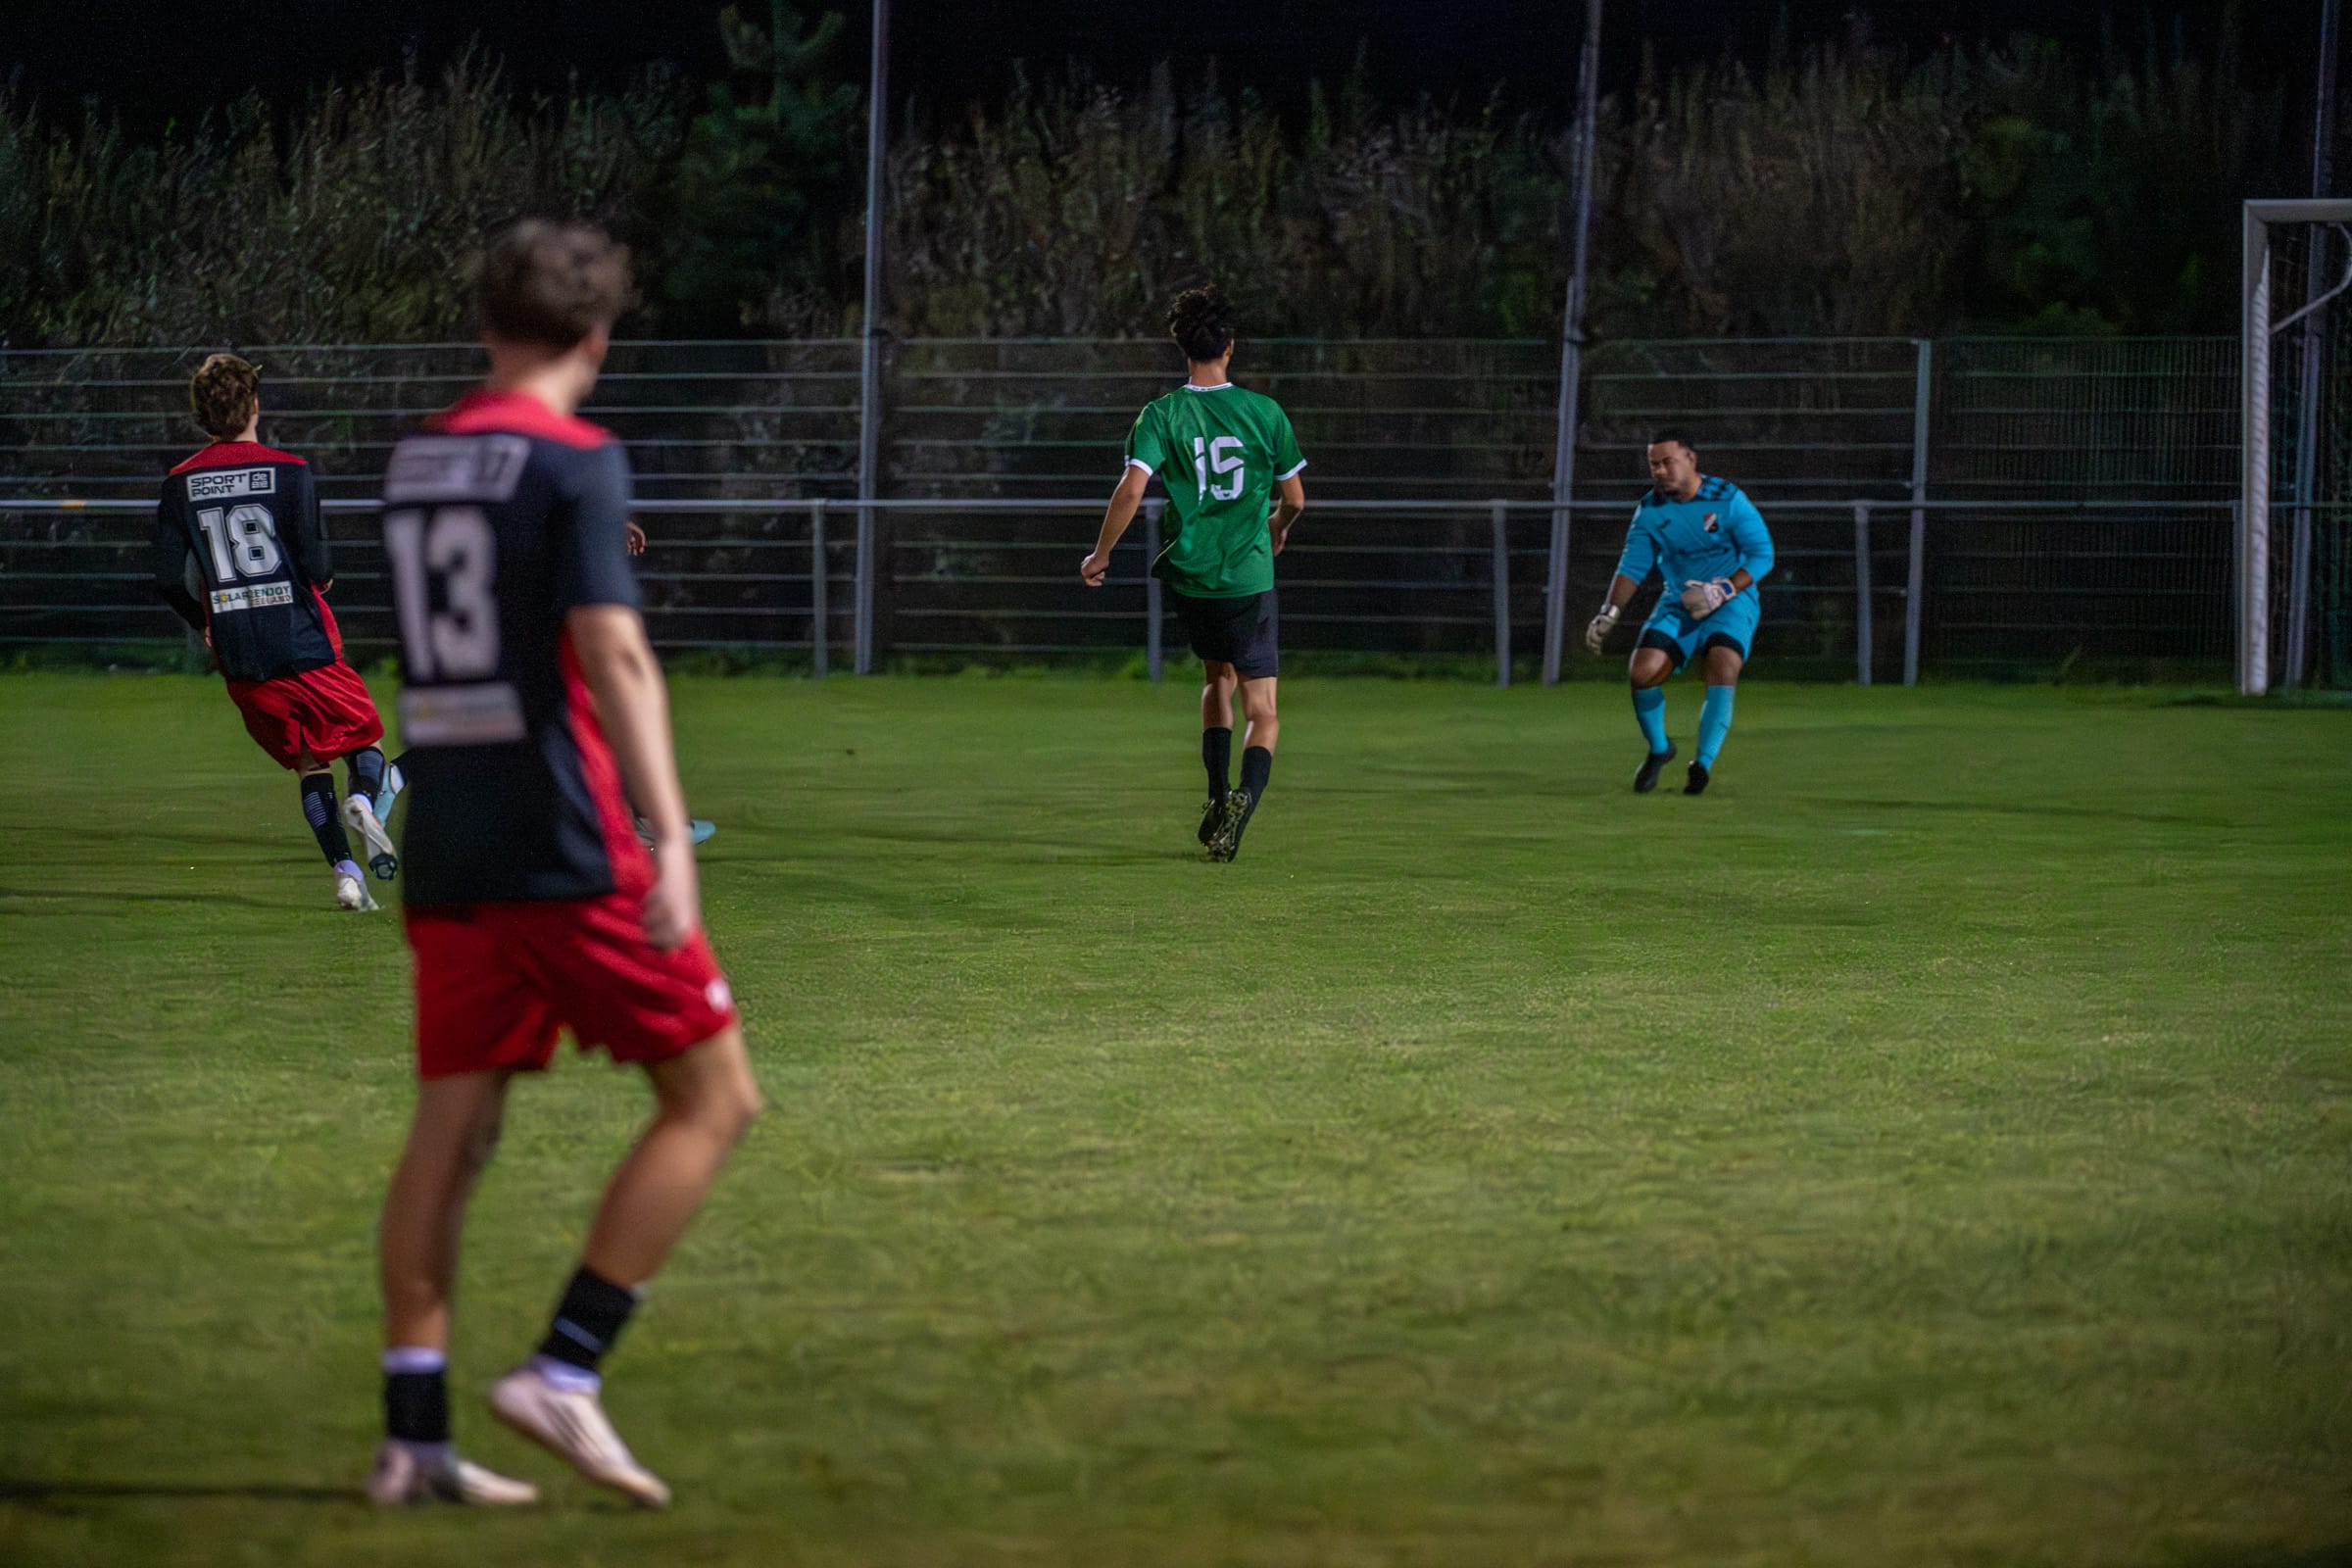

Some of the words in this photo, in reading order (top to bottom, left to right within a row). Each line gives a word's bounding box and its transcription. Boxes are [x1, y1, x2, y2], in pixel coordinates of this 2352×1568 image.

[190, 473, 247, 488] SPORT
[191, 485, 235, 497] POINT
[1194, 436, 1244, 505] 15
[197, 503, 282, 583] 18
[383, 506, 498, 681] 13
